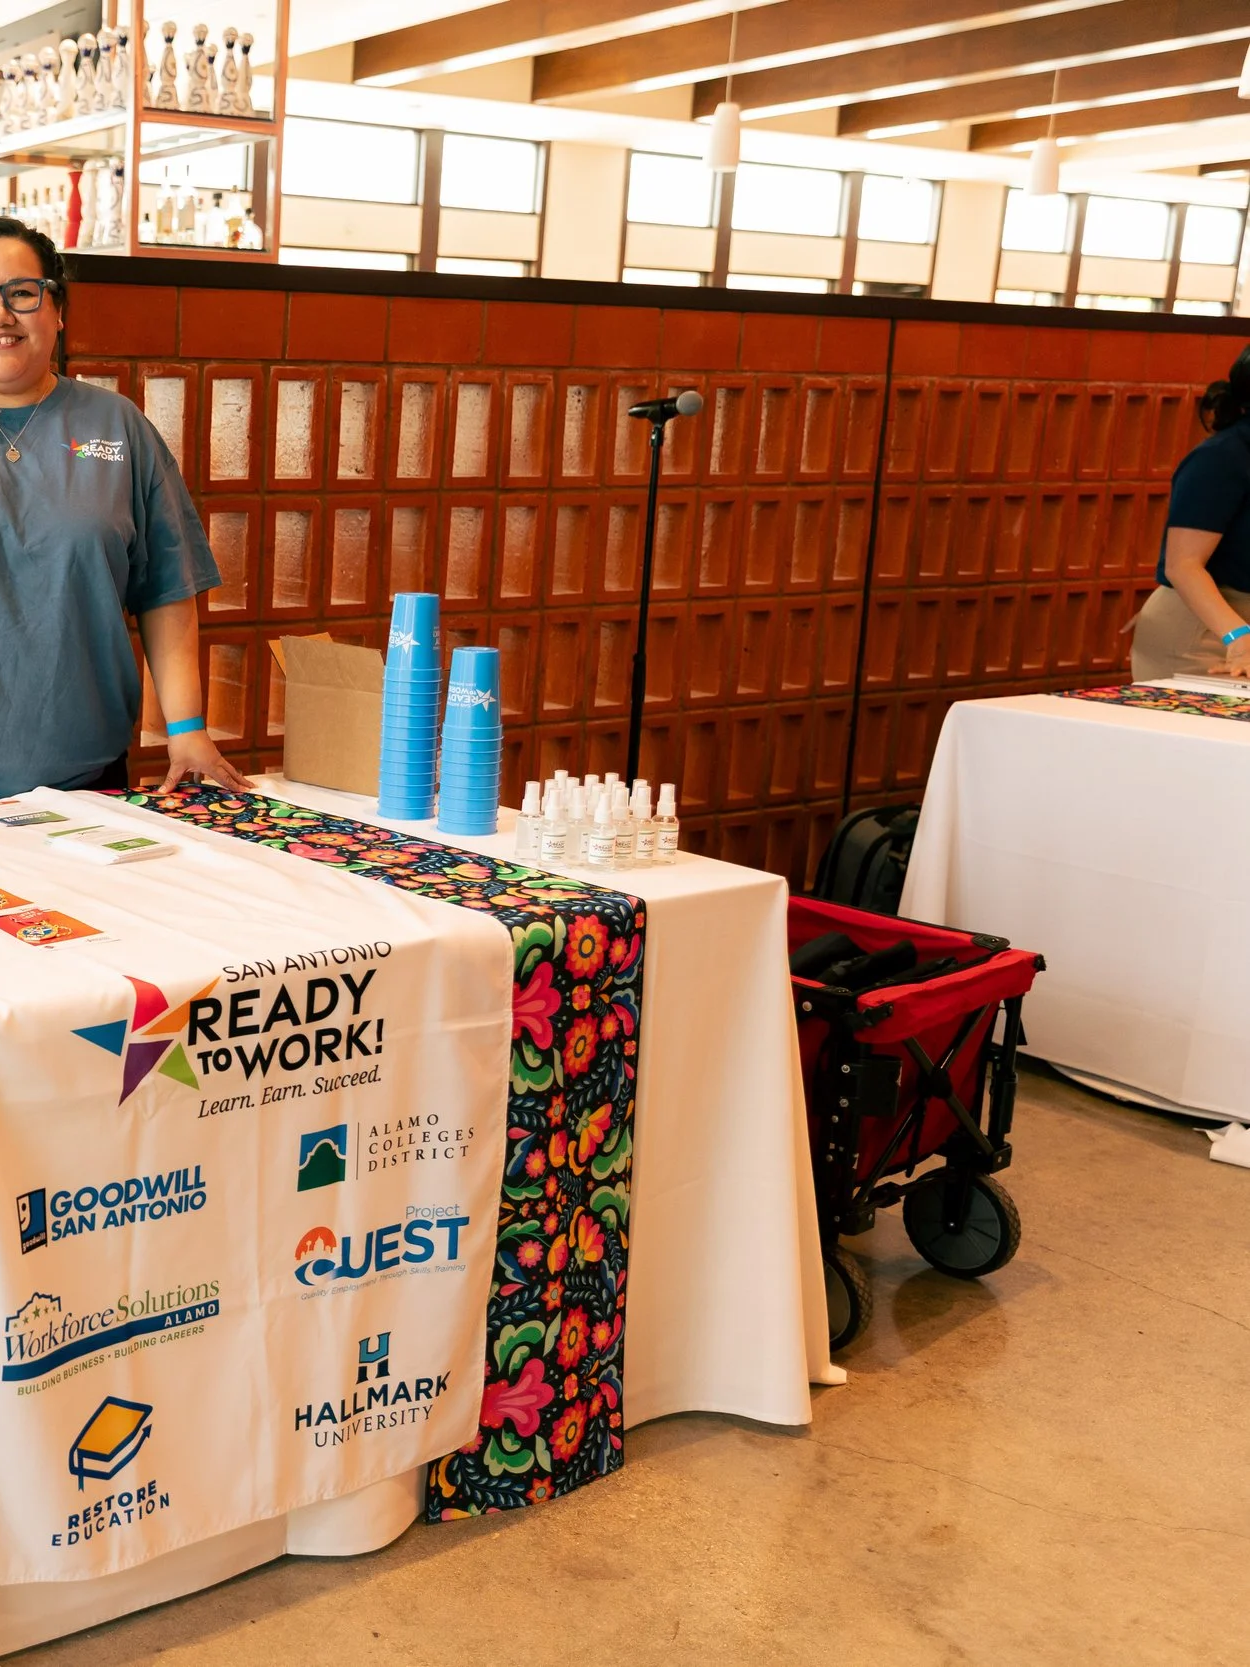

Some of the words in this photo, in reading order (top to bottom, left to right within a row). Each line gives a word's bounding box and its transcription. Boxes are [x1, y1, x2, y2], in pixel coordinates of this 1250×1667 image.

[81, 443, 121, 455] READY
[92, 451, 124, 461] WORK!
[222, 959, 276, 983] SAN
[283, 941, 392, 974] ANTONIO
[188, 968, 378, 1046] READY
[196, 1047, 233, 1075] TO
[234, 1018, 385, 1082] WORK!
[197, 1094, 255, 1119] Learn.
[261, 1083, 307, 1106] Earn.
[312, 1064, 382, 1095] Succeed.
[368, 1127, 475, 1155] COLLEGES
[369, 1113, 440, 1138] ALAMO
[368, 1145, 470, 1172] DISTRICT
[50, 1164, 206, 1218] GOODWILL
[405, 1203, 461, 1220] Project
[51, 1213, 96, 1242] SAN
[102, 1190, 207, 1230] ANTONIO
[164, 1303, 216, 1327] ALAMO
[17, 1373, 61, 1396] BUILDING
[63, 1354, 105, 1380] BUSINESS
[114, 1337, 157, 1359] BUILDING
[159, 1324, 205, 1344] CAREERS
[294, 1370, 451, 1432] HALLMARK
[314, 1404, 434, 1448] UNIVERSITY
[51, 1492, 170, 1547] EDUCATION
[67, 1479, 158, 1530] RESTORE
